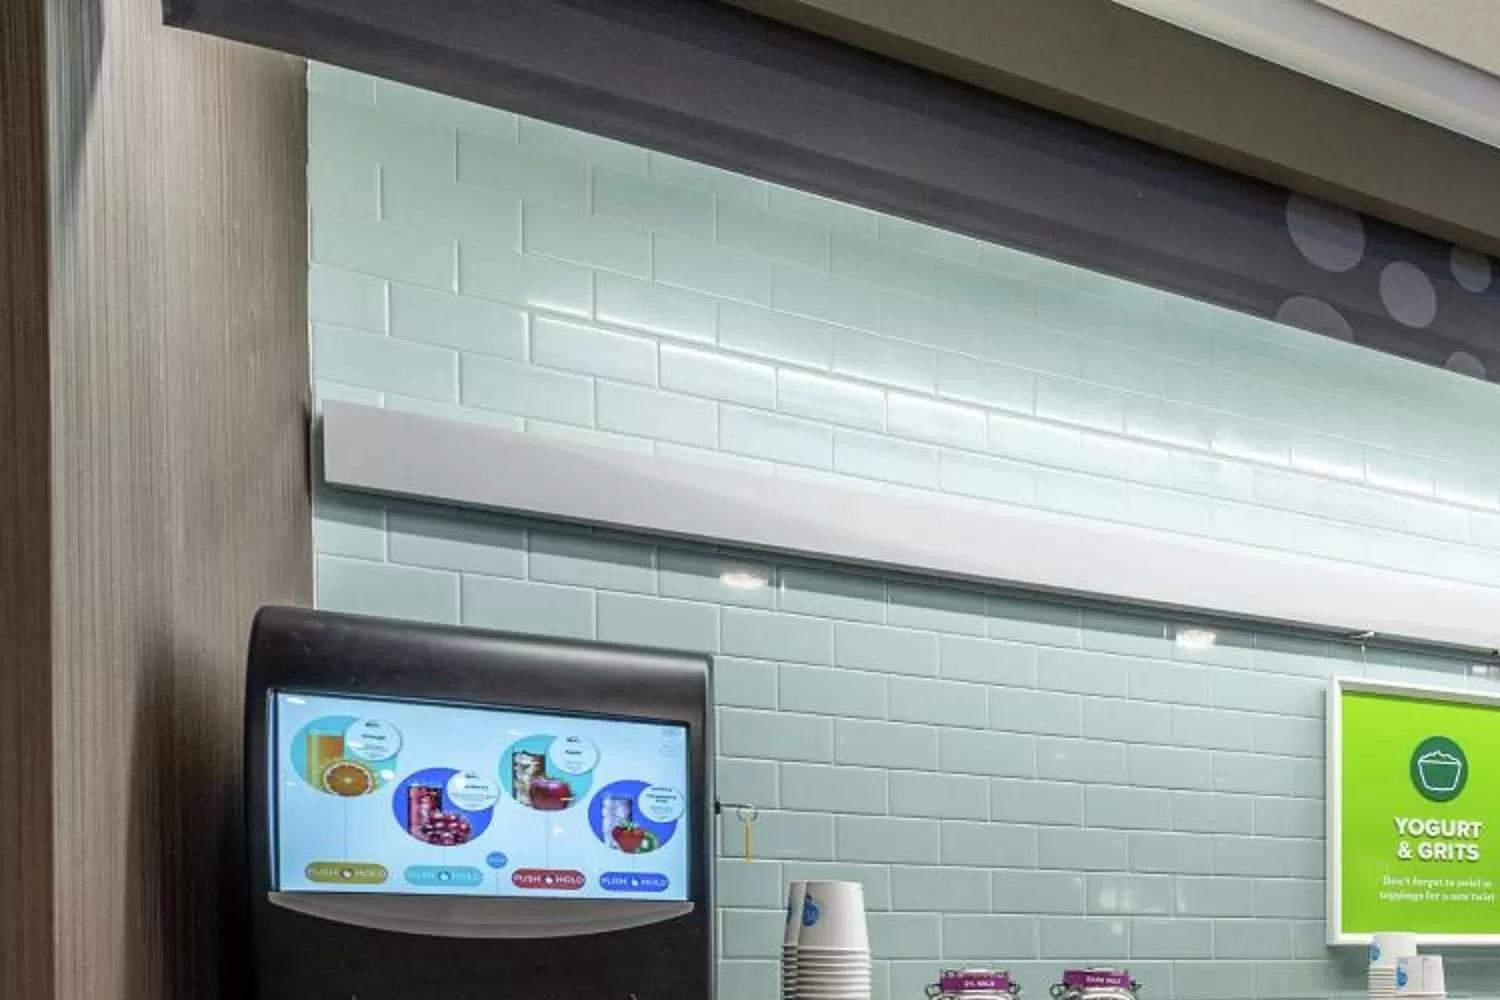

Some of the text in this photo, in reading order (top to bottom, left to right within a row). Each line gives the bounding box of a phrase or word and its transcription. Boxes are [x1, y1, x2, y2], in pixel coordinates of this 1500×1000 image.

[1393, 816, 1483, 838] YOGURT
[1397, 840, 1480, 861] & GRITS
